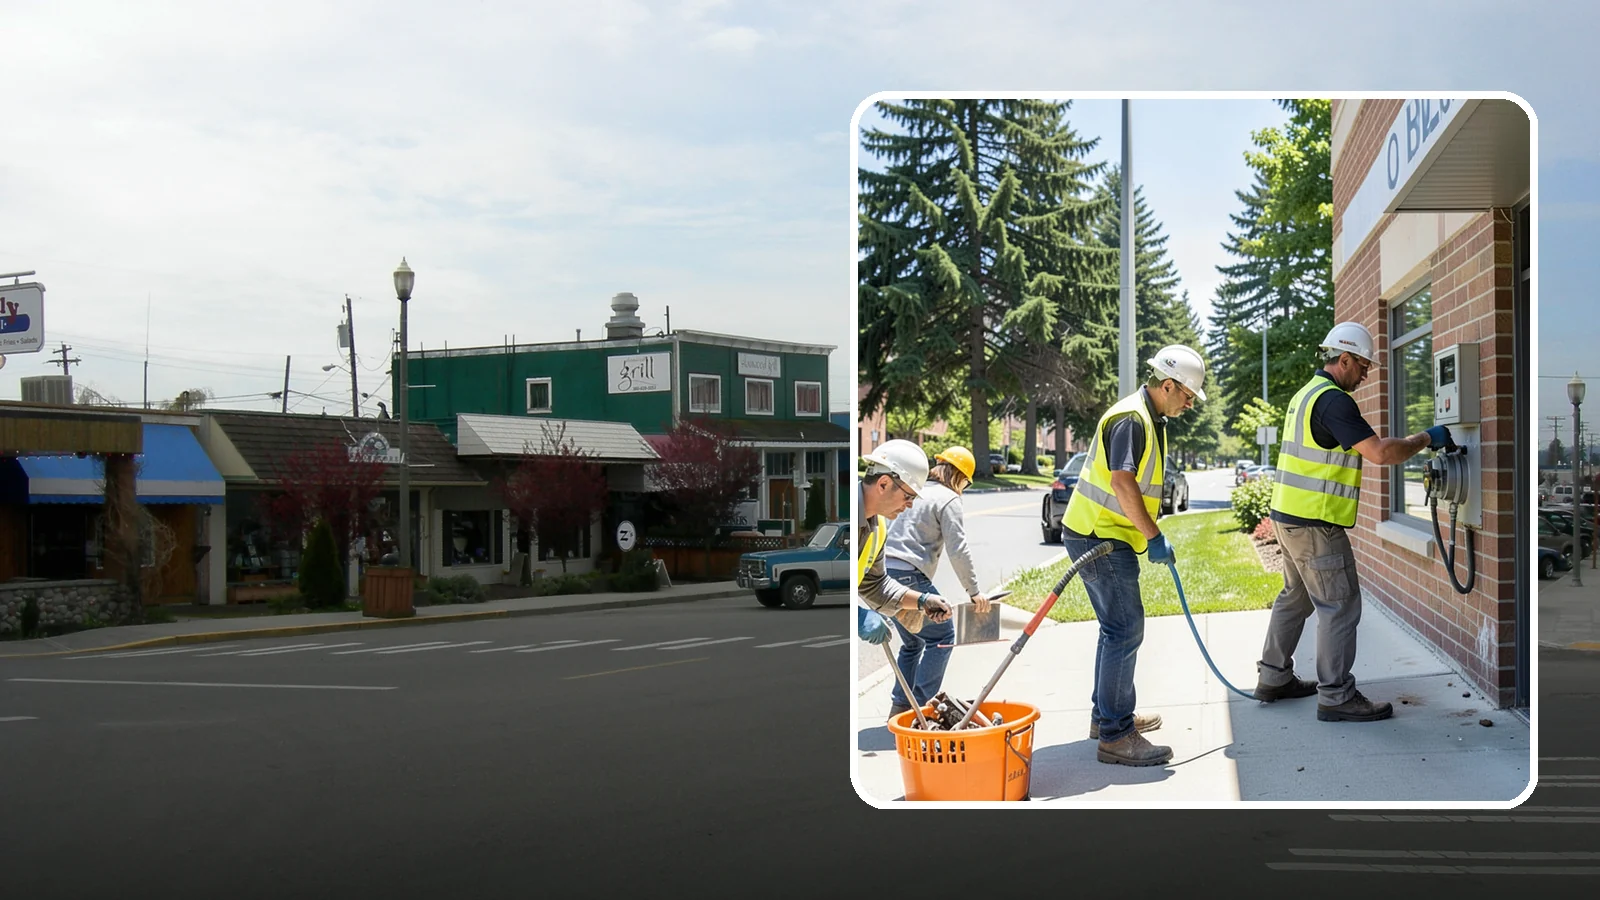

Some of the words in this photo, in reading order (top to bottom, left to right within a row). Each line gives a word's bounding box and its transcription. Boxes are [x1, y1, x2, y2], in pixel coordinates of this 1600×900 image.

[0, 297, 19, 323] ly
[20, 337, 38, 345] Salads
[618, 356, 654, 391] grill
